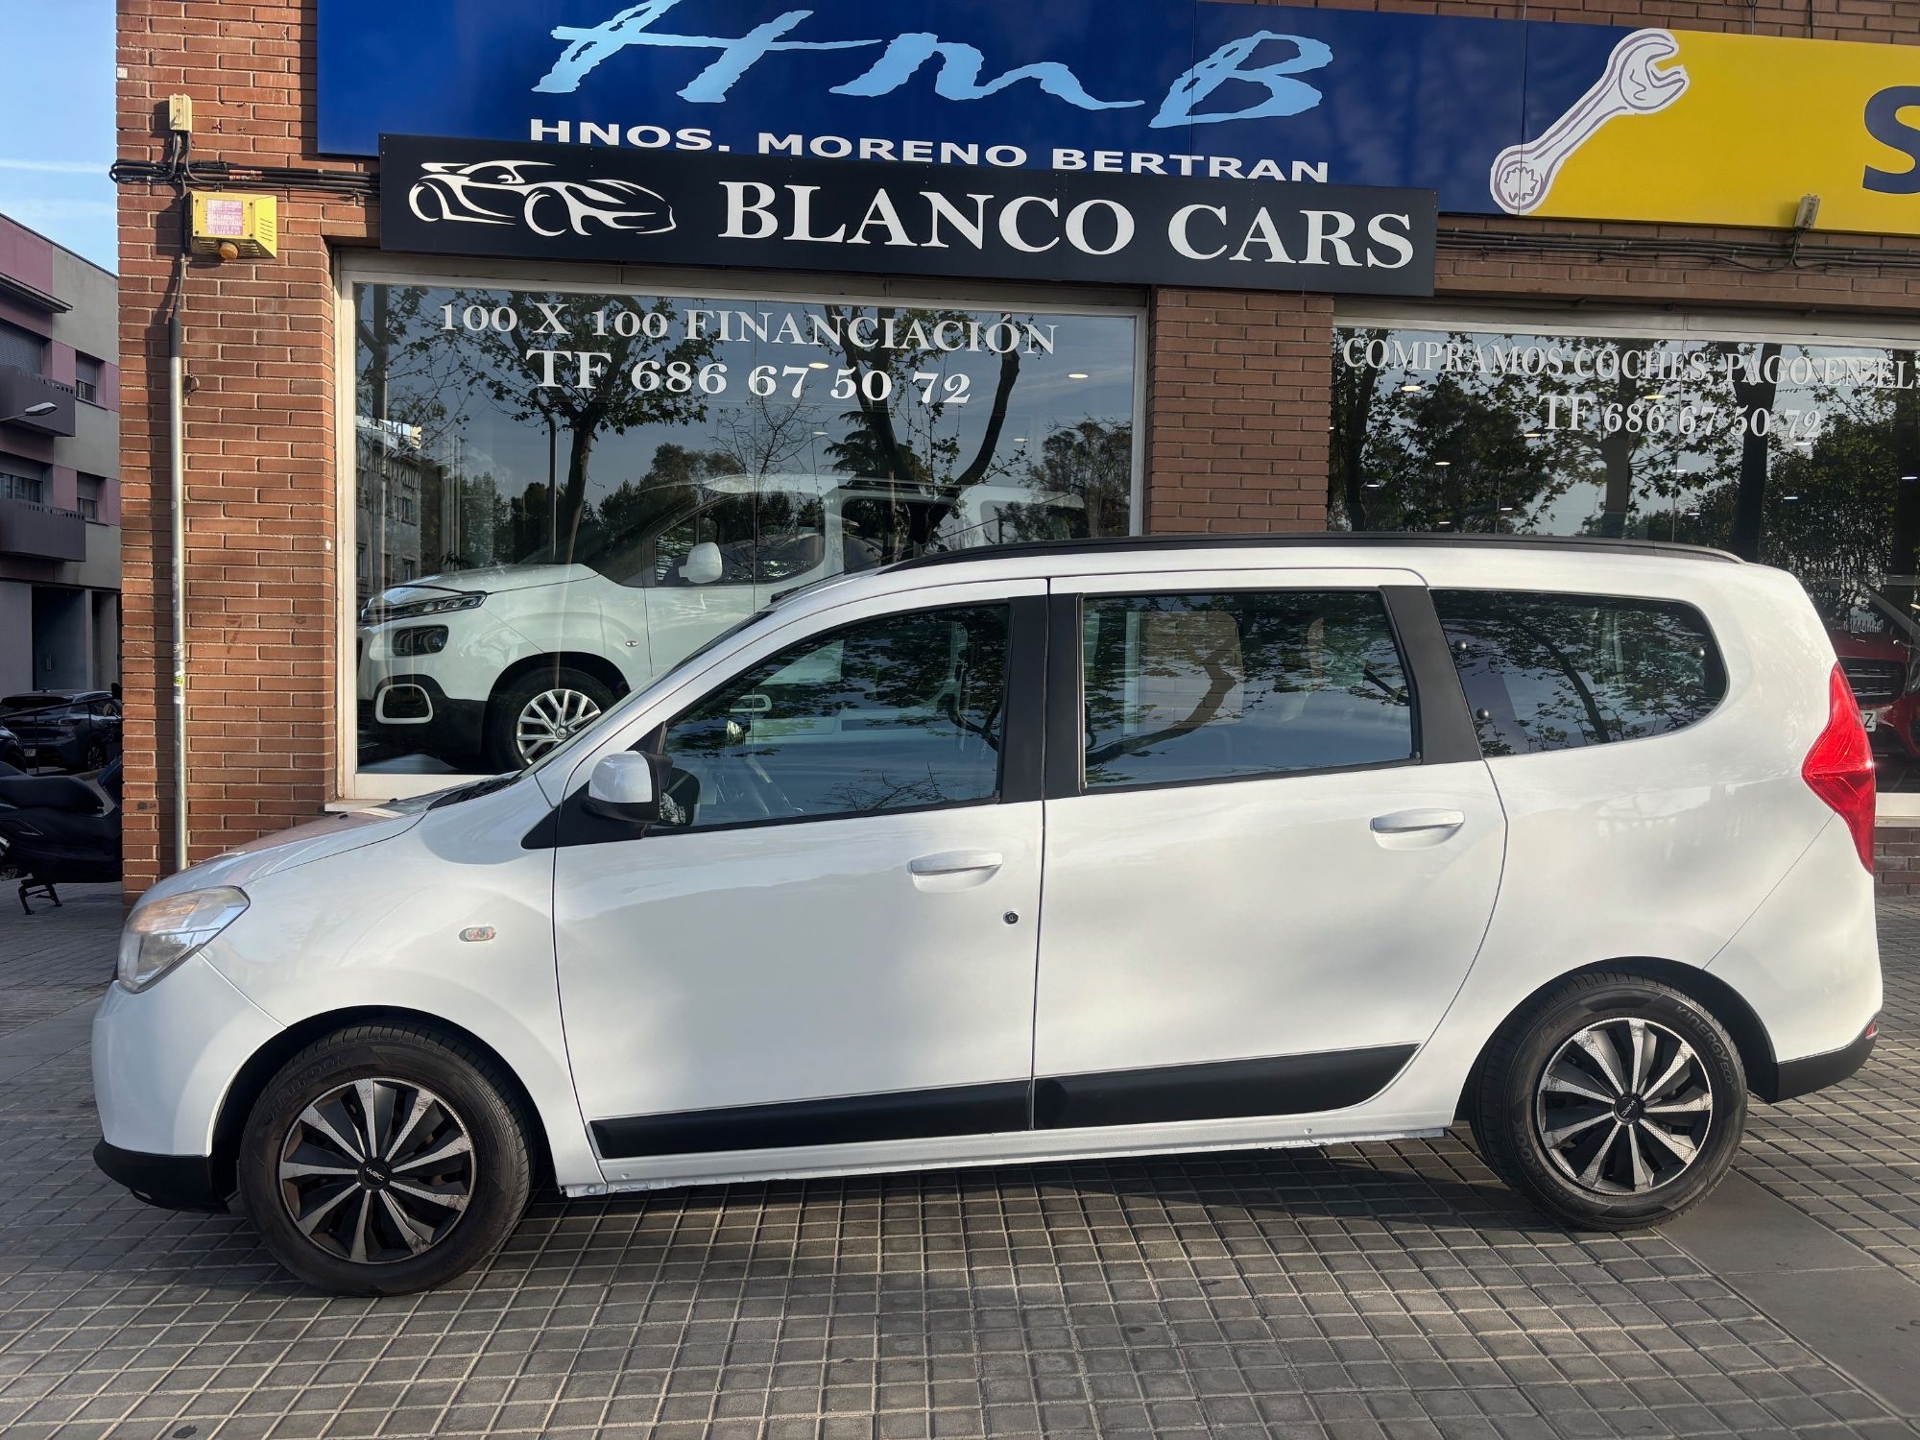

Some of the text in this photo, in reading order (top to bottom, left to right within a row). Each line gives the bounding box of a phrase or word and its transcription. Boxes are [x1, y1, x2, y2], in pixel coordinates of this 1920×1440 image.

[530, 118, 1329, 183] HNOS. MORENO BERTRAN
[718, 180, 1414, 269] BLANCO CARS
[439, 302, 1059, 355] 100 X 100 FINANCIACIÓN
[525, 349, 971, 404] TF 686 67 50 72
[1342, 337, 1564, 376] COMPRAMOS
[1726, 353, 1812, 387] PAGO
[1821, 356, 1864, 387] EN
[1538, 394, 1822, 439] TF 686 67 50 72
